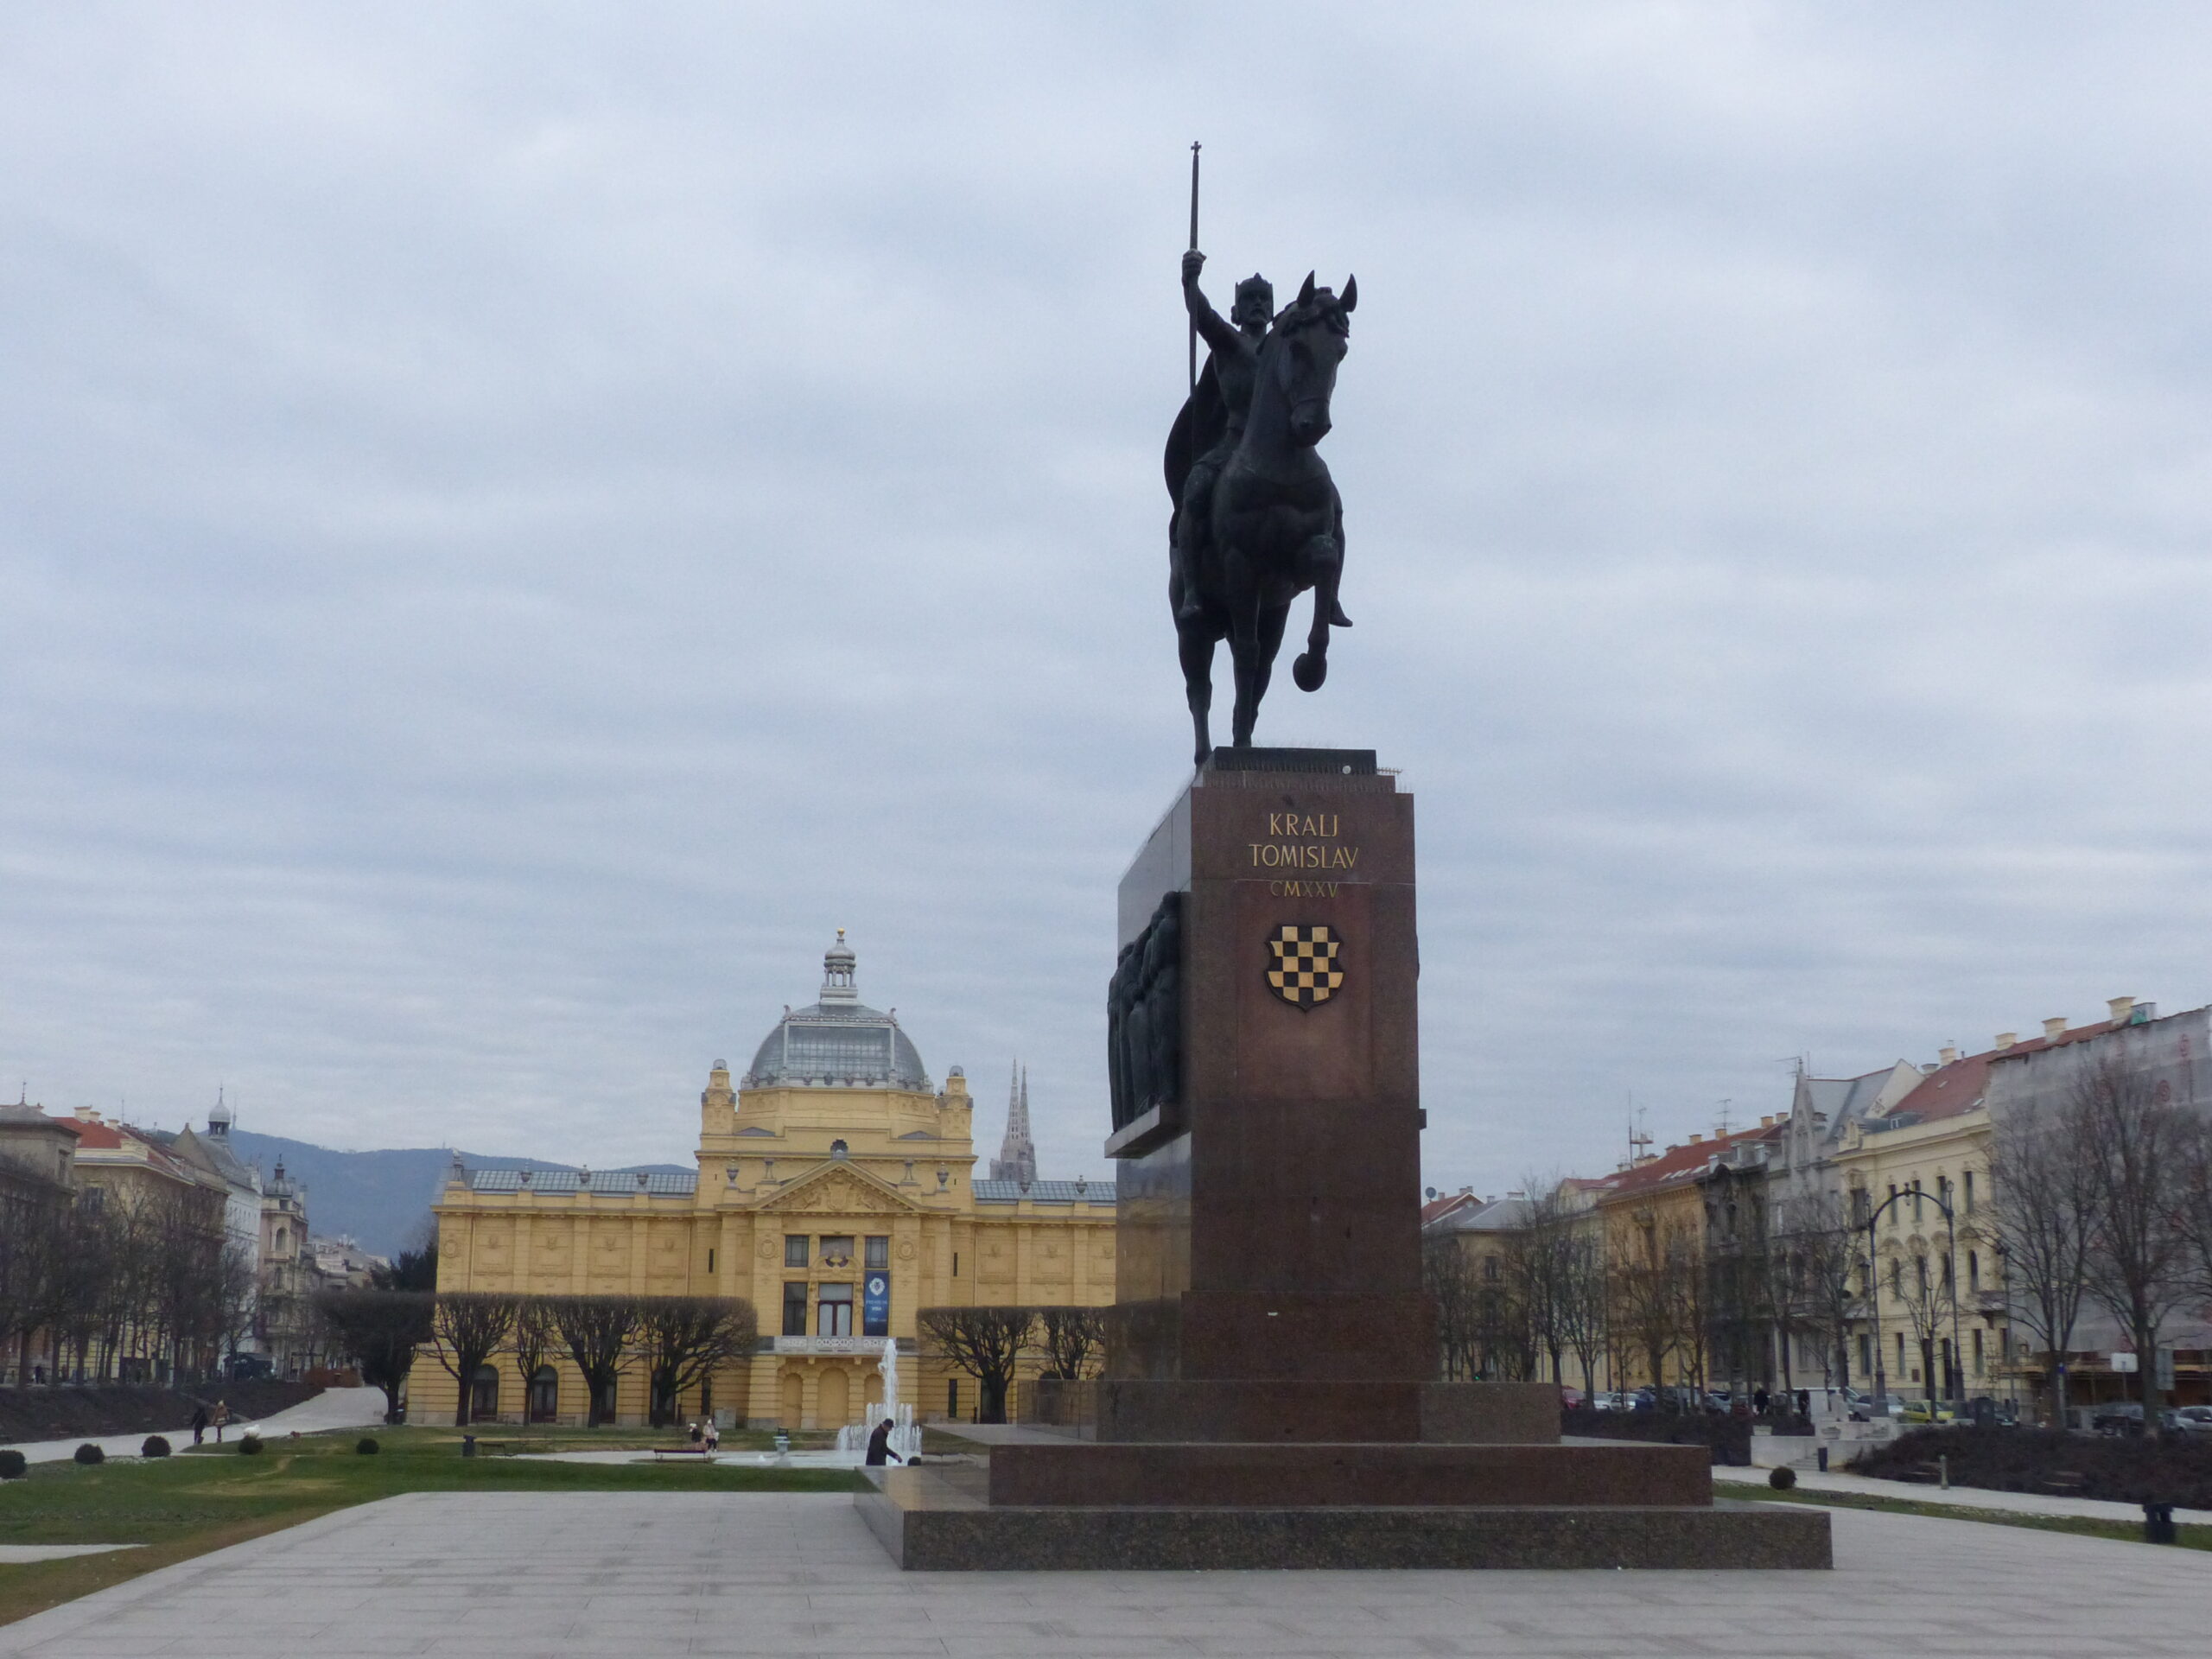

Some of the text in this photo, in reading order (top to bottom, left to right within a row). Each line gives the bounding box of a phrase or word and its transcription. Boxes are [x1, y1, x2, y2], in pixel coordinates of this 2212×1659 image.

[1269, 812, 1338, 837] KRALJ
[1248, 843, 1359, 869] TOMISLAV
[1270, 880, 1339, 899] CMXXV
